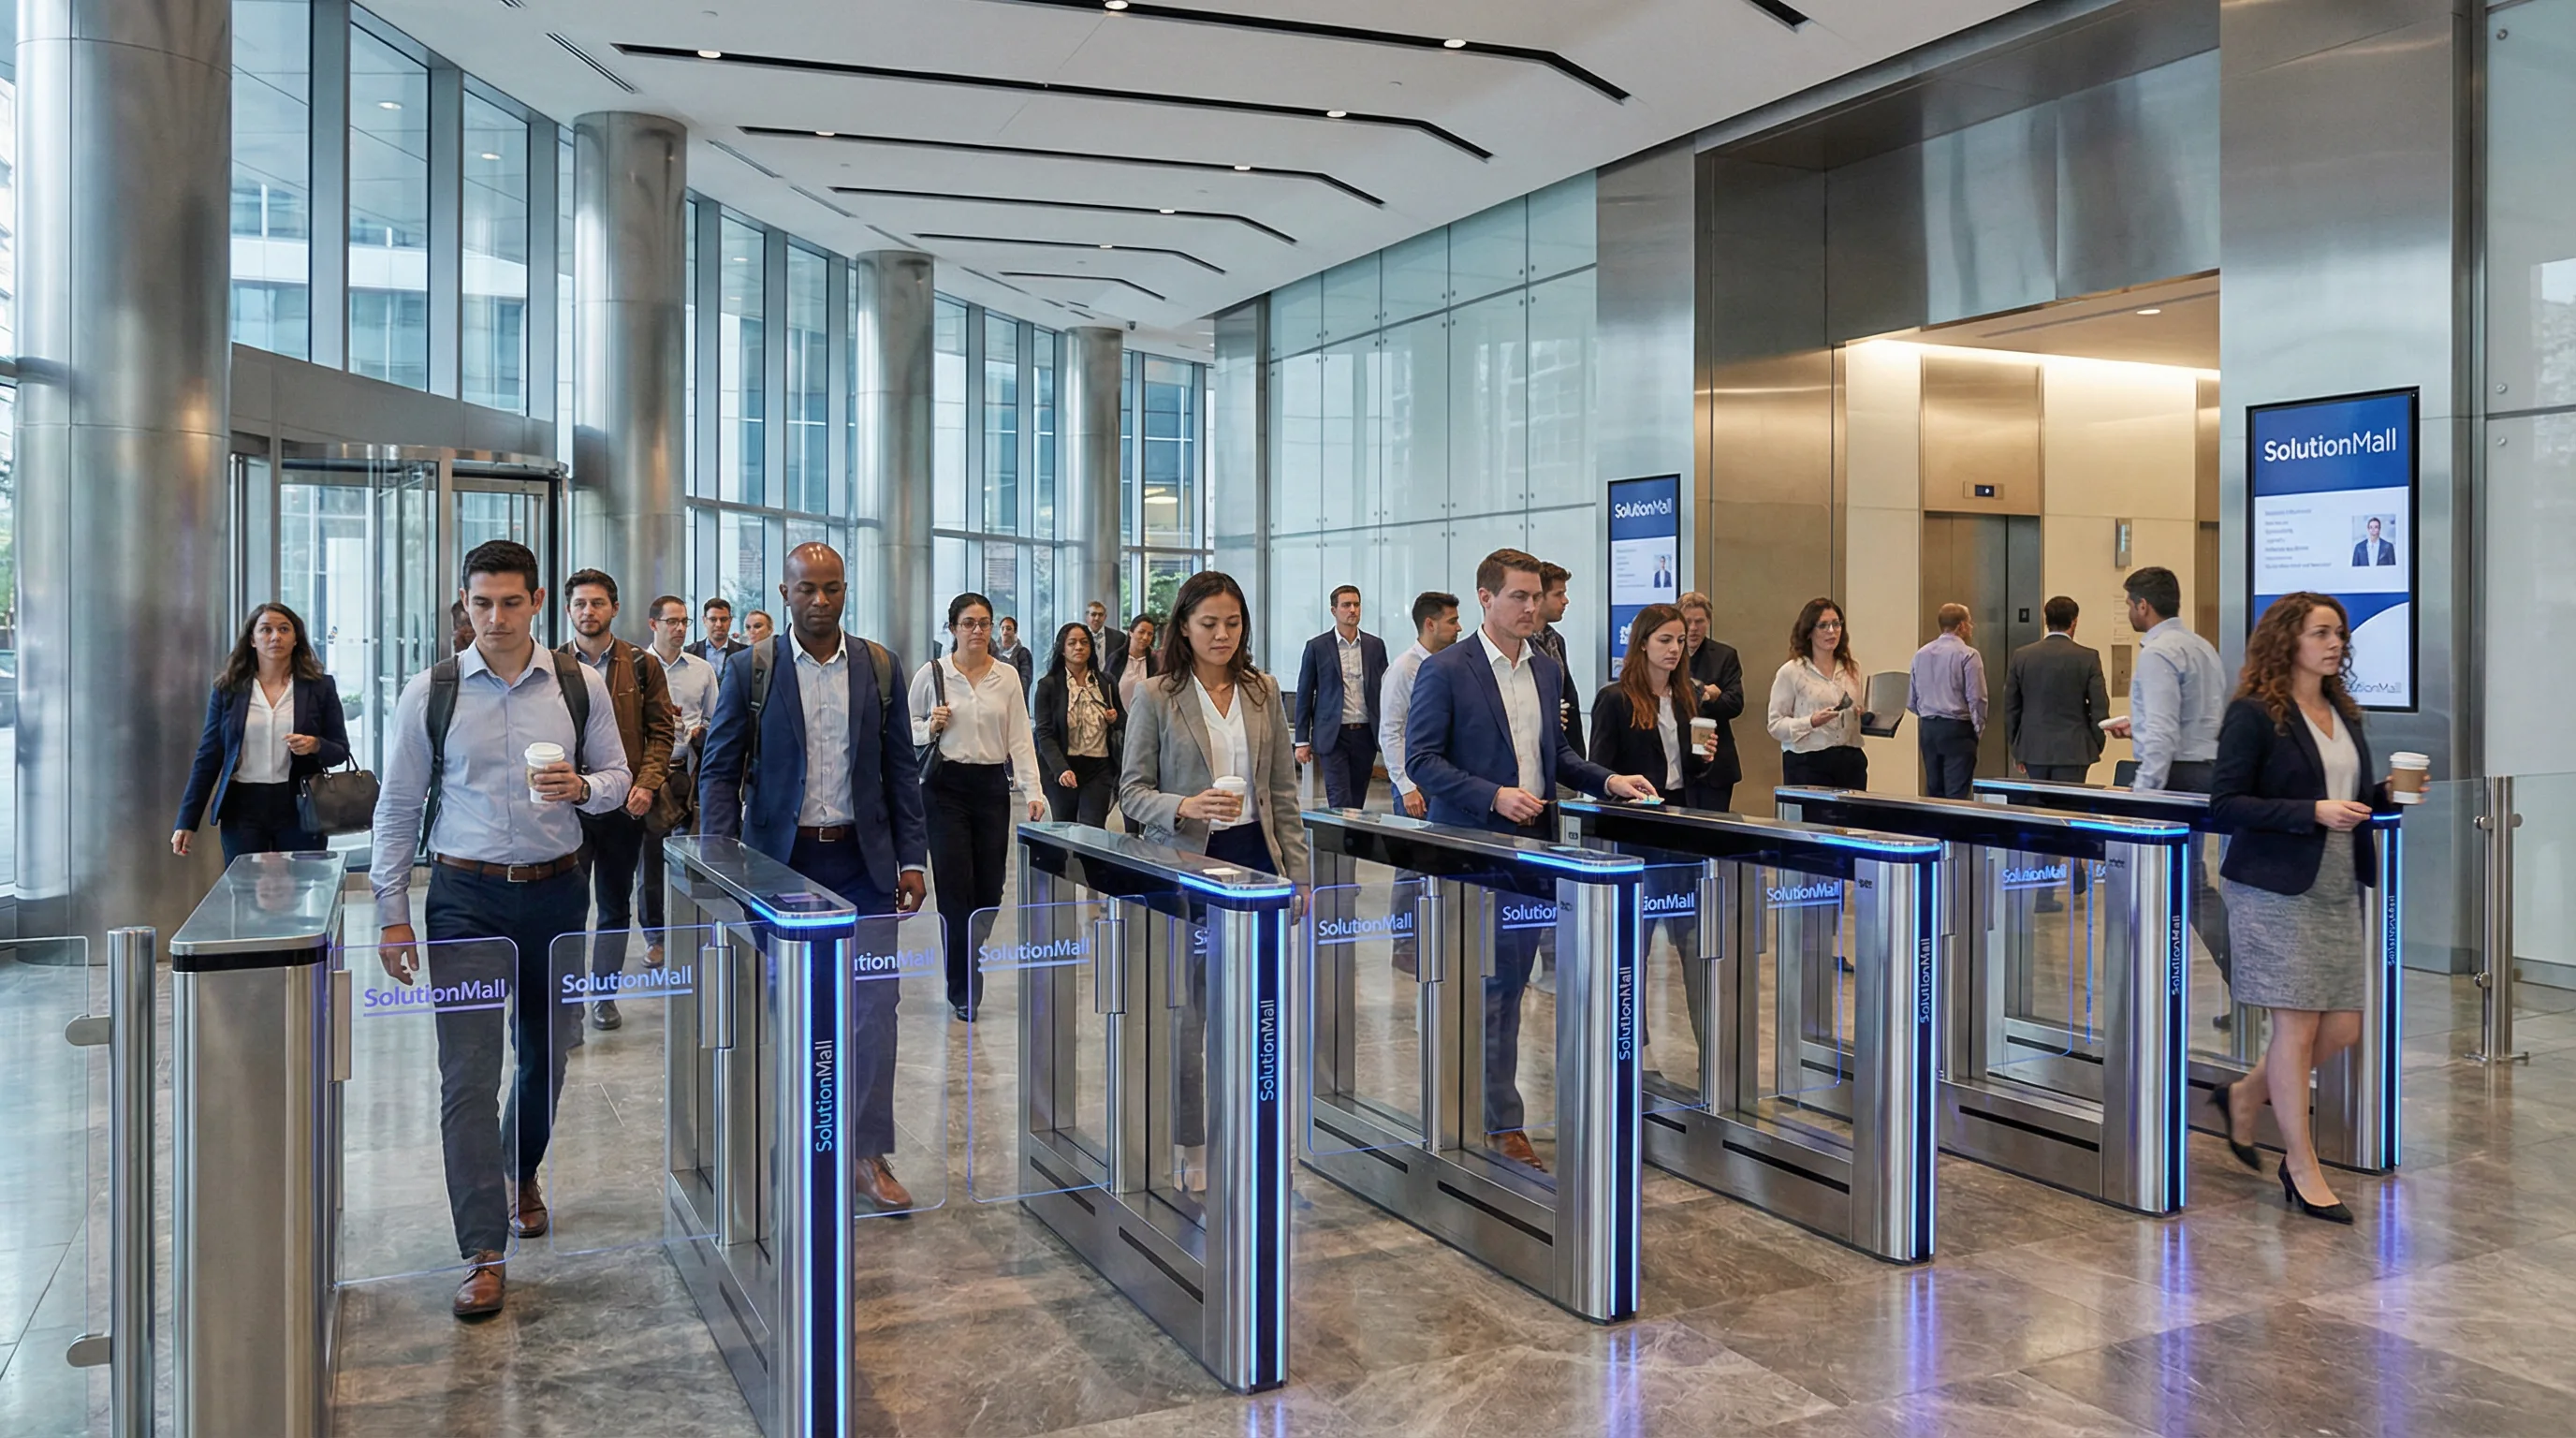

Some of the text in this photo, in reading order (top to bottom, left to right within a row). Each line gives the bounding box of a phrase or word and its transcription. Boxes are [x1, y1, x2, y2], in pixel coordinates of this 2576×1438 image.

[2263, 427, 2397, 462] SolutionMall
[1766, 881, 1839, 902] SolutionMall
[1318, 912, 1412, 936] SolutionMall
[977, 936, 1090, 963] SolutionMall
[363, 978, 506, 1008] SolutionMall
[562, 965, 693, 994] SolutionMall
[1618, 966, 1632, 1061] SolutionMall
[1258, 999, 1276, 1102] SolutionMall
[814, 1039, 833, 1152] SolutionMall
